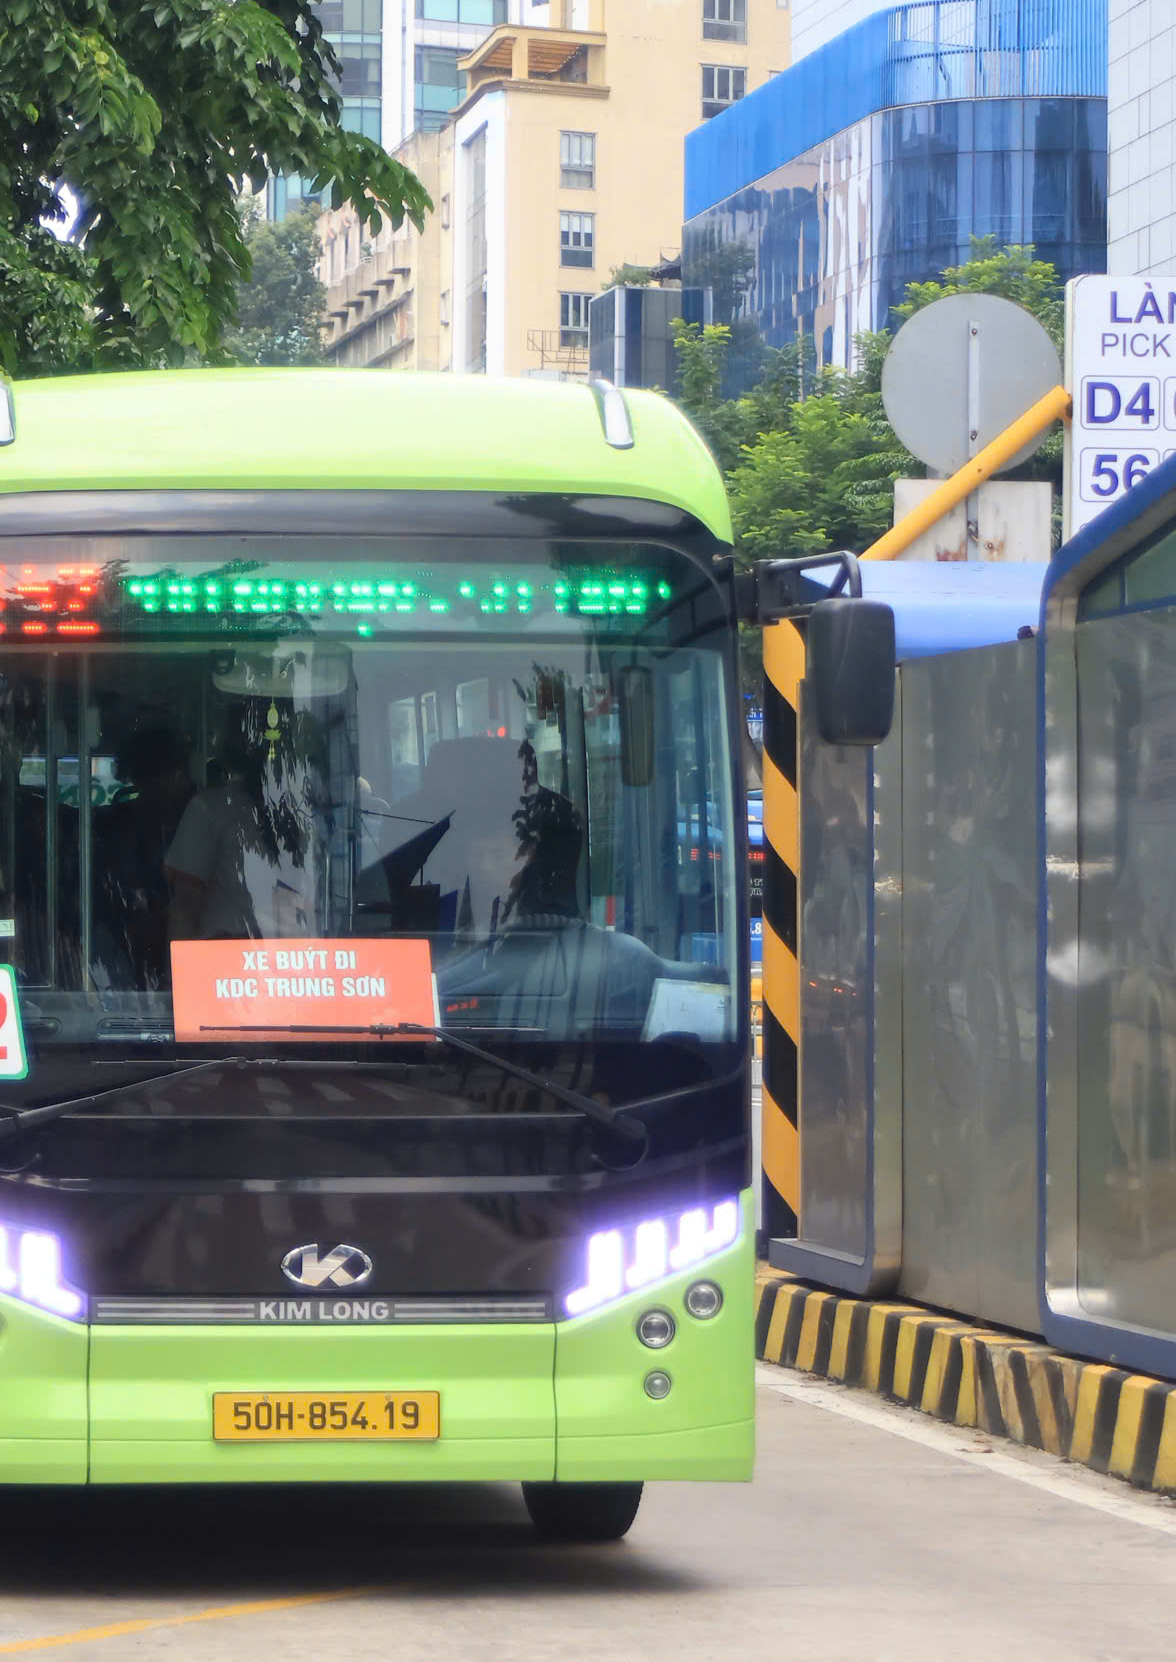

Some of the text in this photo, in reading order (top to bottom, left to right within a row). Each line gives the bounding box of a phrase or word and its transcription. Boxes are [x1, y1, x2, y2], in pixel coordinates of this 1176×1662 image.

[1100, 332, 1172, 358] PICK
[1085, 381, 1156, 425] D4
[1090, 453, 1151, 497] 56
[242, 946, 357, 971] XE BUÝT ĐI
[215, 975, 386, 999] KDC TRUNG SƠN
[259, 1301, 390, 1320] KIM LONG
[233, 1400, 420, 1431] 50H-854.19
